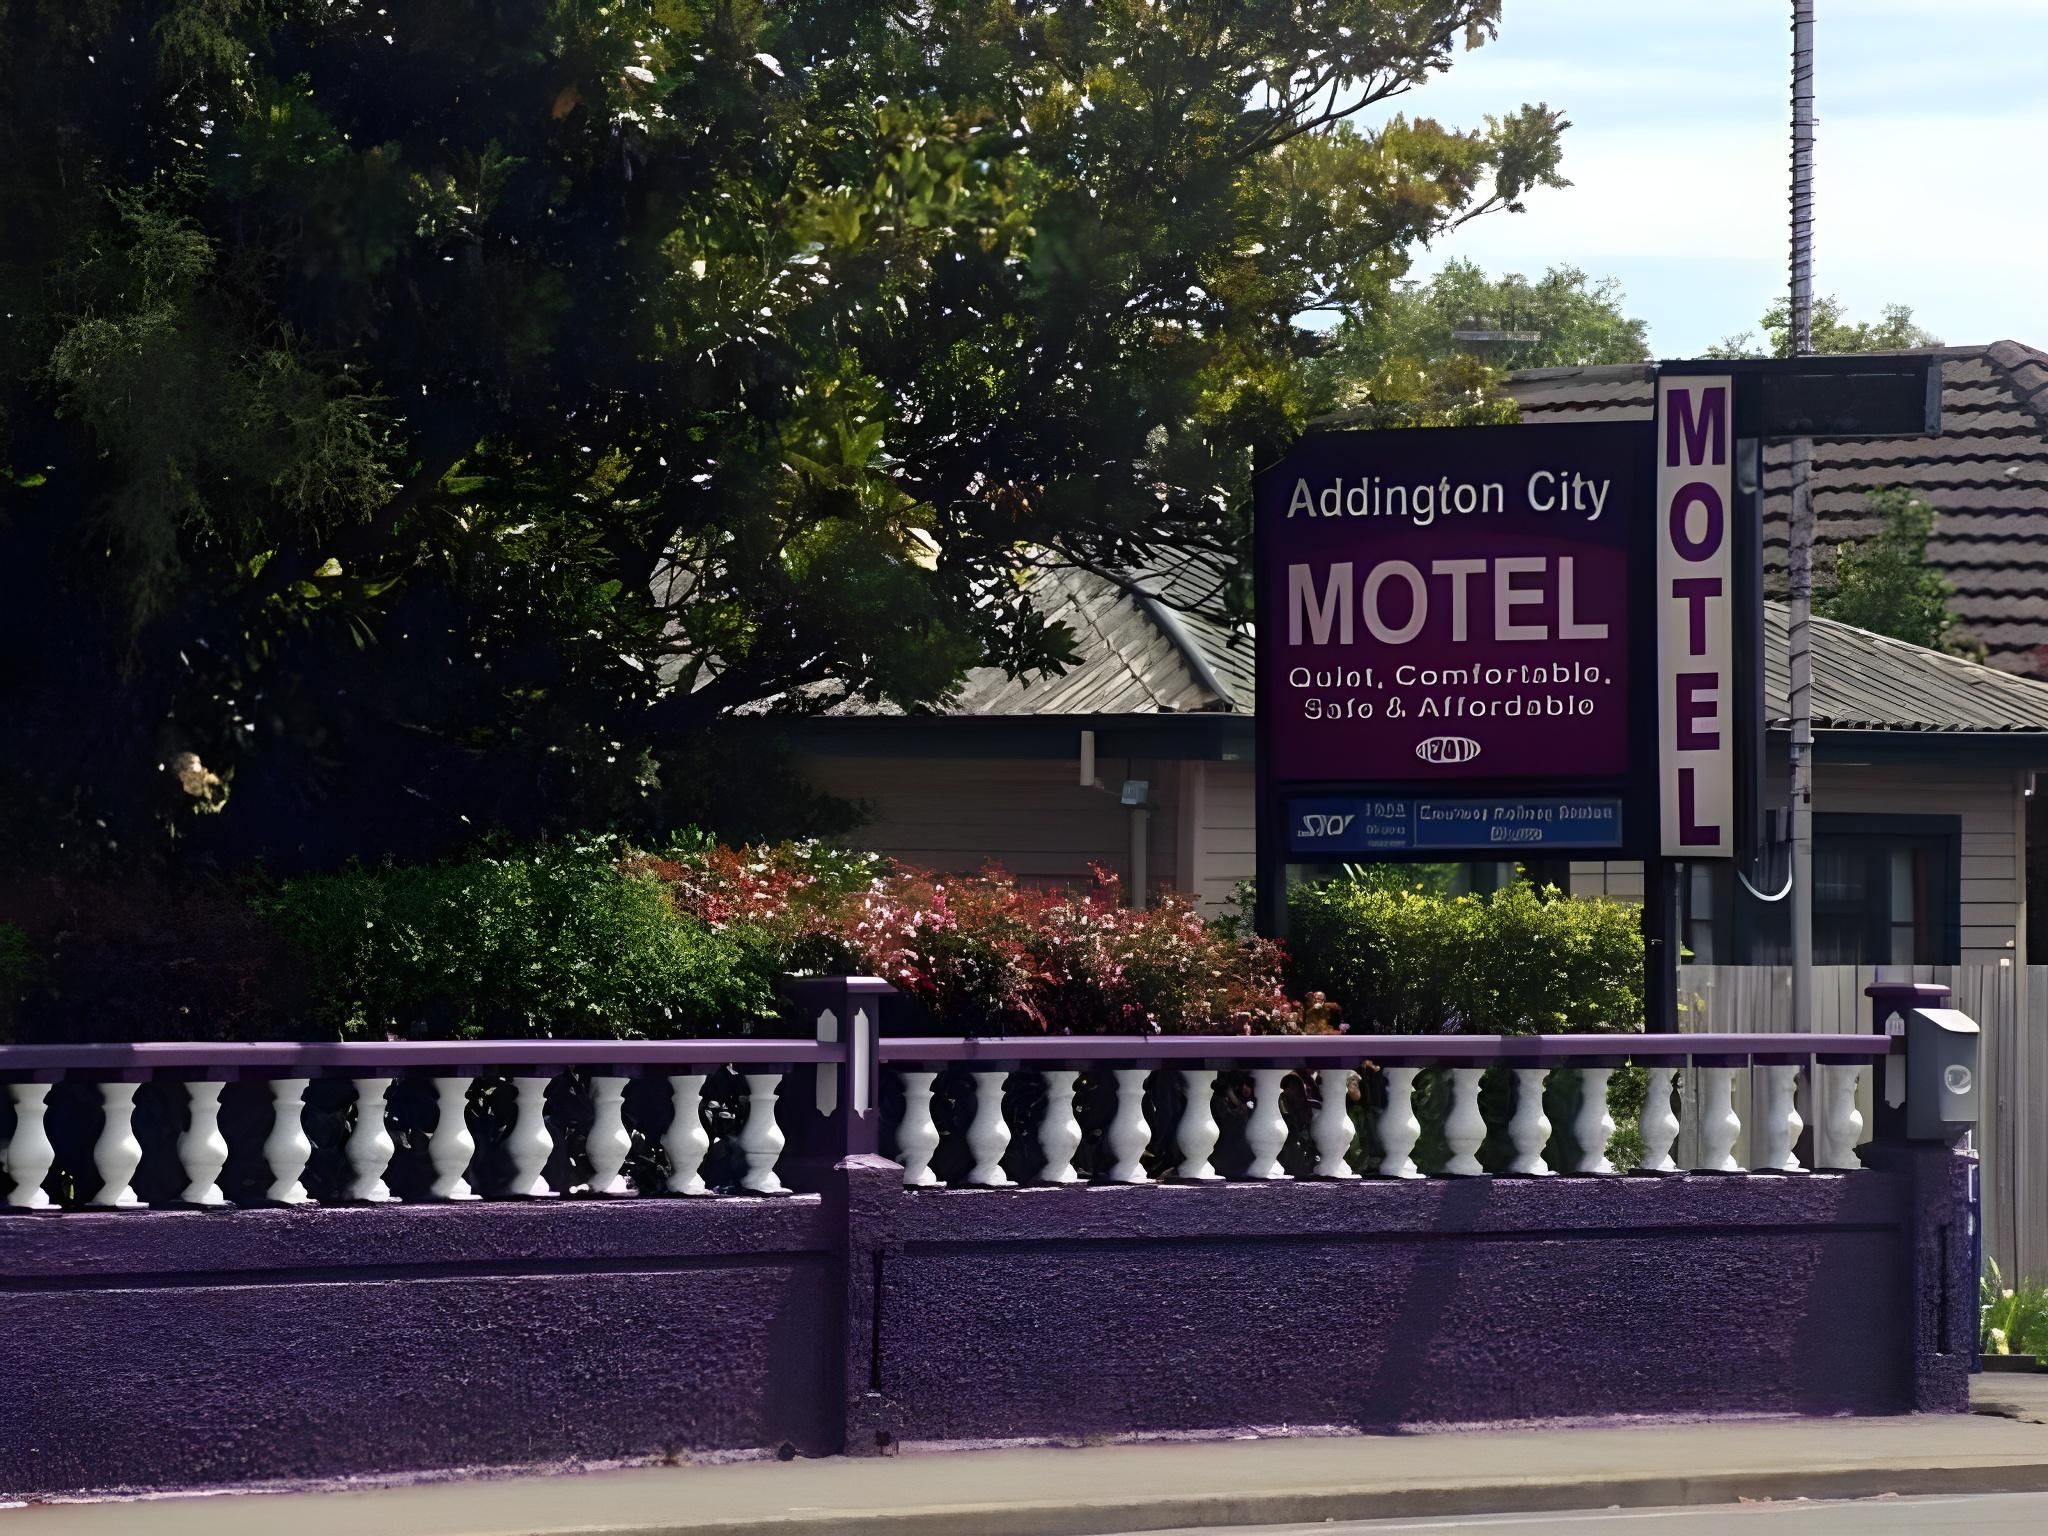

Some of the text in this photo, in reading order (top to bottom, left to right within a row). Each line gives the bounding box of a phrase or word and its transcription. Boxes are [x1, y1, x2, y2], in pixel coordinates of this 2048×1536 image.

[1287, 470, 1611, 526] Addington City
[1288, 556, 1609, 646] MOTEL
[1666, 387, 1726, 847] MOTEL
